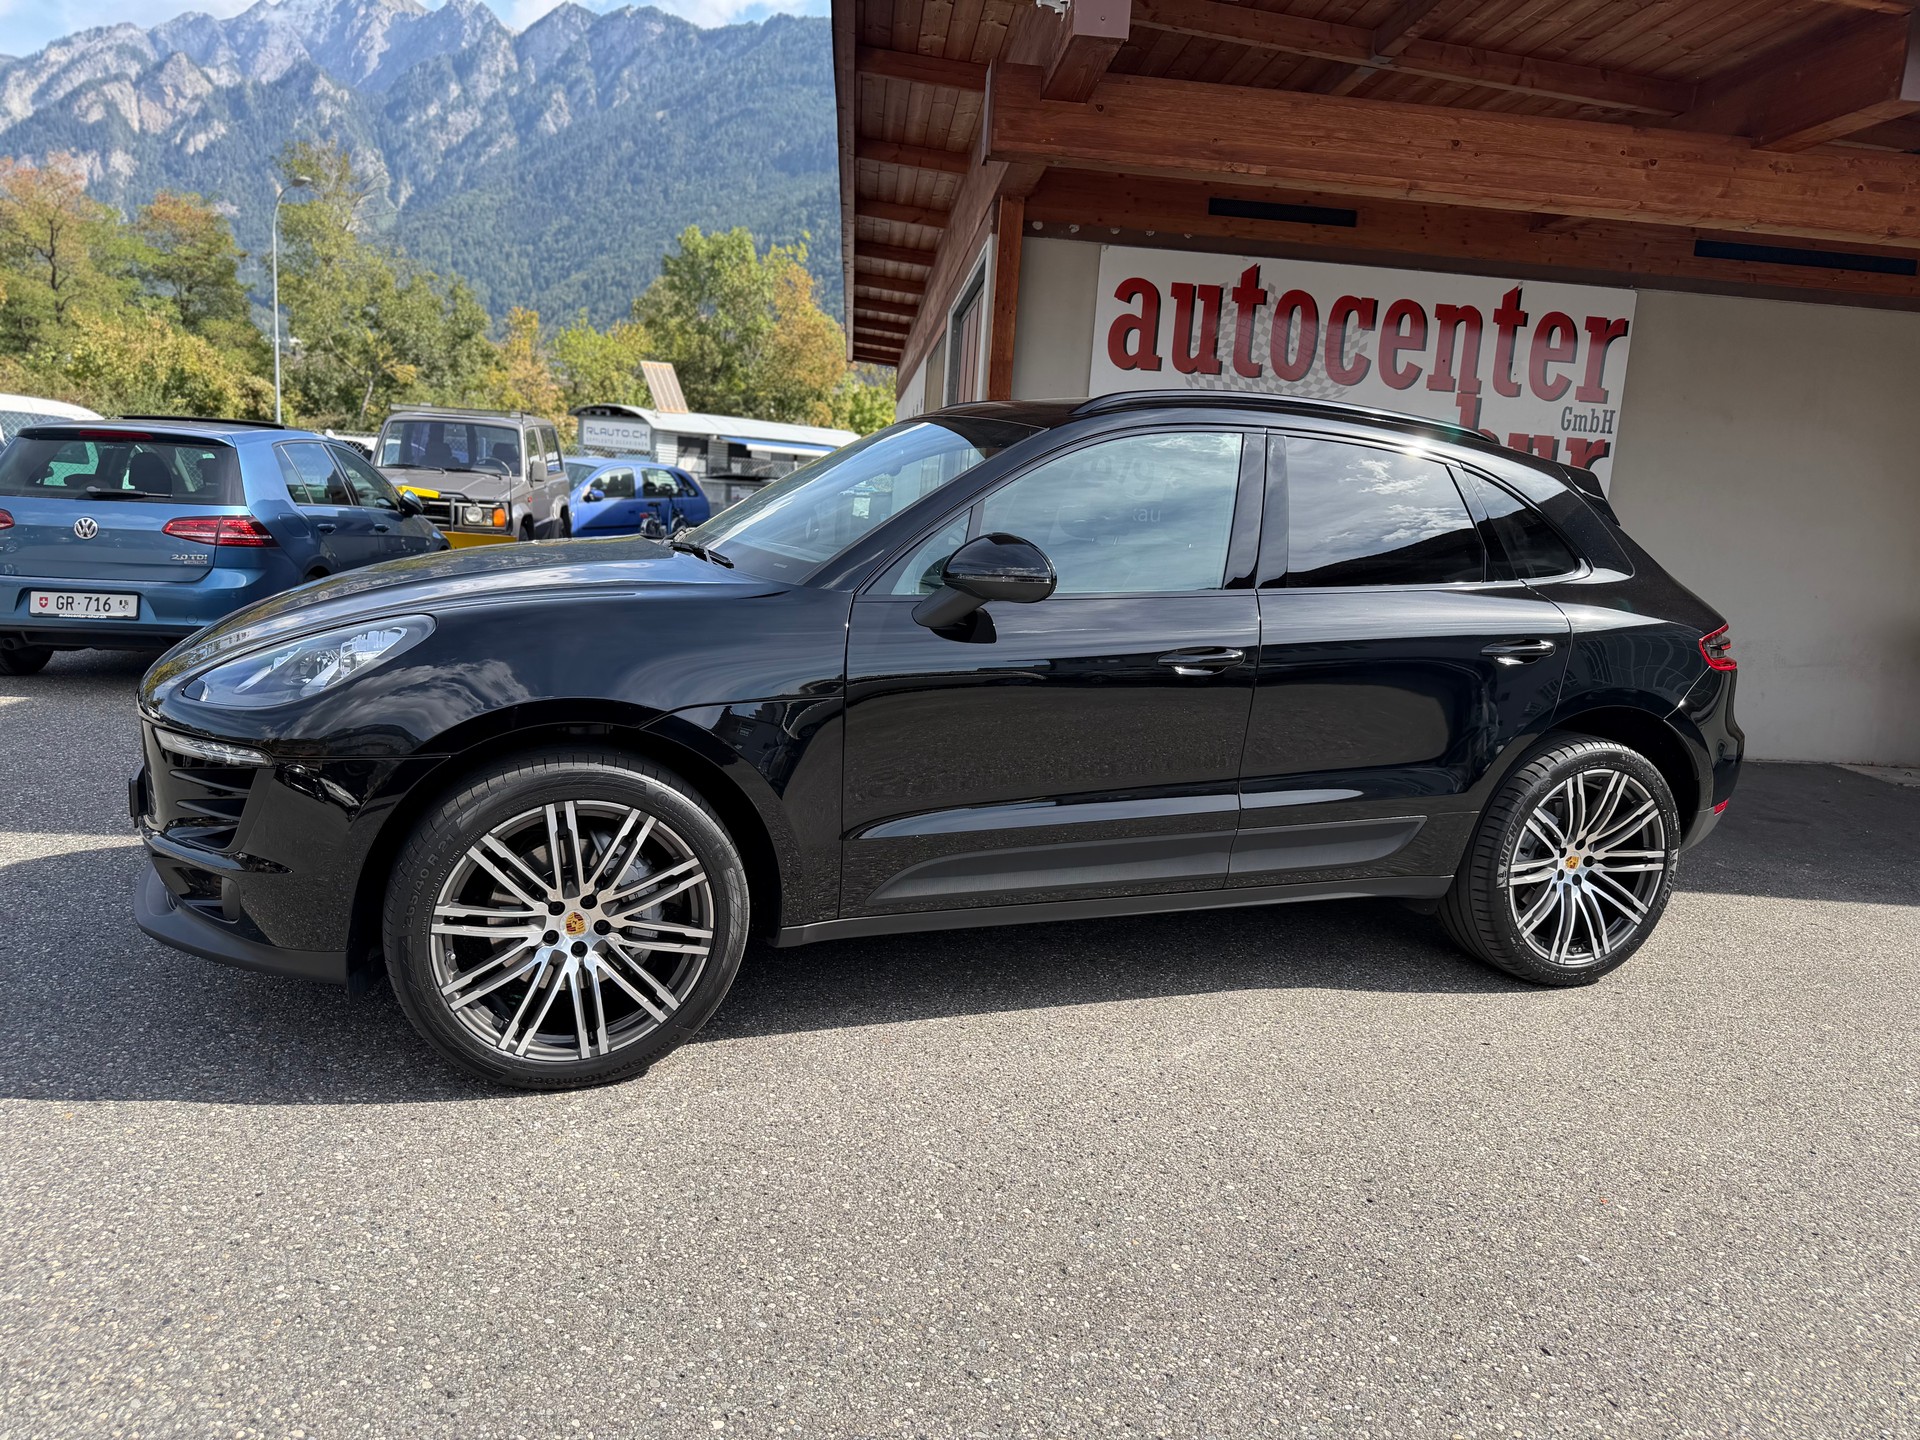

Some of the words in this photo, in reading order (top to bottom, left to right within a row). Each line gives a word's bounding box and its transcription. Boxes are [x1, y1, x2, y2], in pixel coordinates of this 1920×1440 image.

[1107, 263, 1629, 404] autocenter
[1561, 406, 1616, 434] GmbH
[586, 426, 648, 439] RLAUTO.CH
[438, 833, 456, 852] 21
